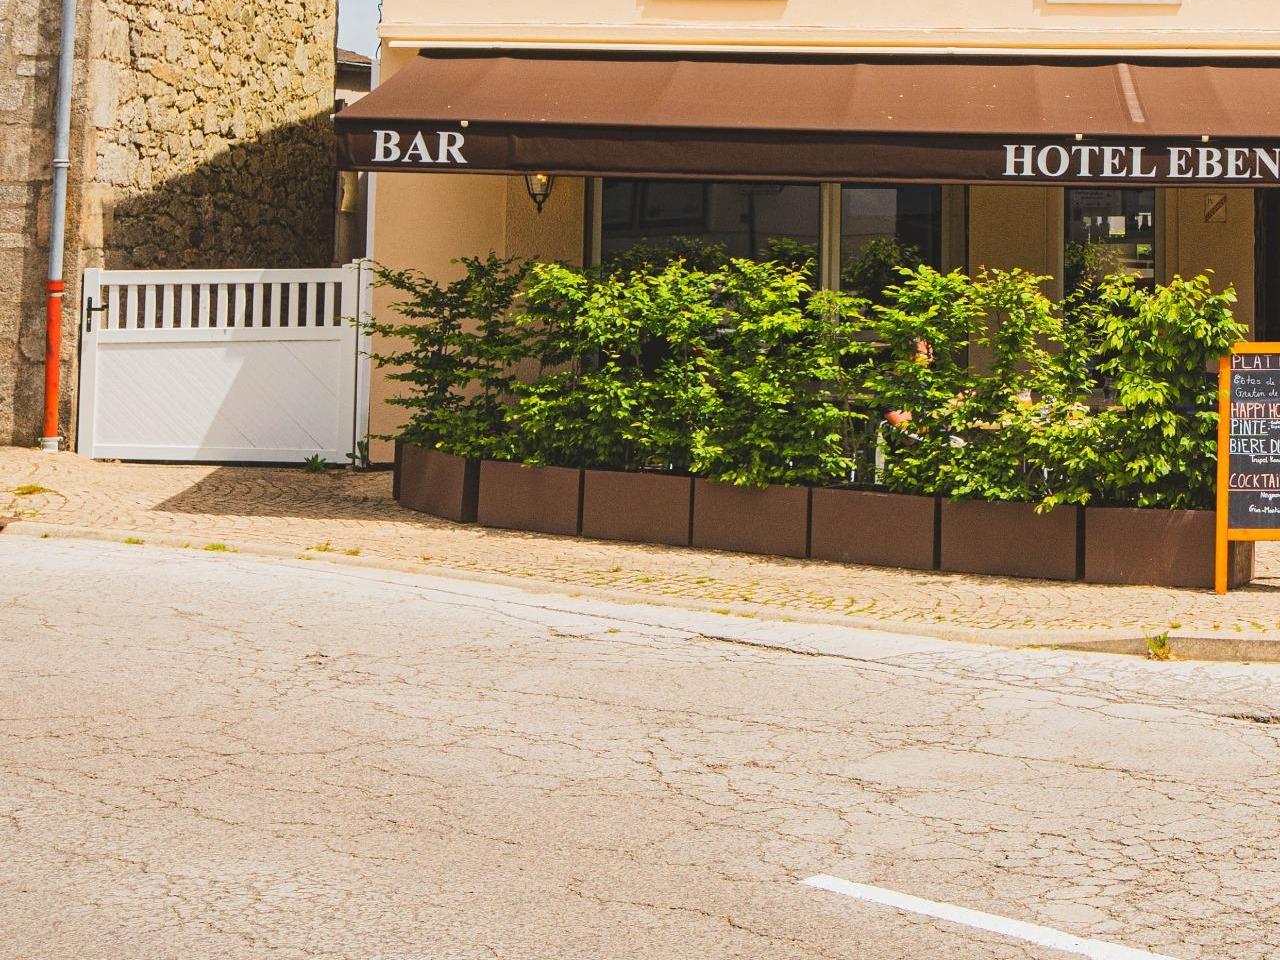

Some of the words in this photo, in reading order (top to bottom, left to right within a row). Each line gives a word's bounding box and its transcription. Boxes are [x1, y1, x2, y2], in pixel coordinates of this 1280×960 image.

[371, 129, 468, 164] BAR
[1002, 144, 1157, 178] HOTEL
[1232, 355, 1272, 369] PLAT
[1231, 402, 1265, 419] HAPPY
